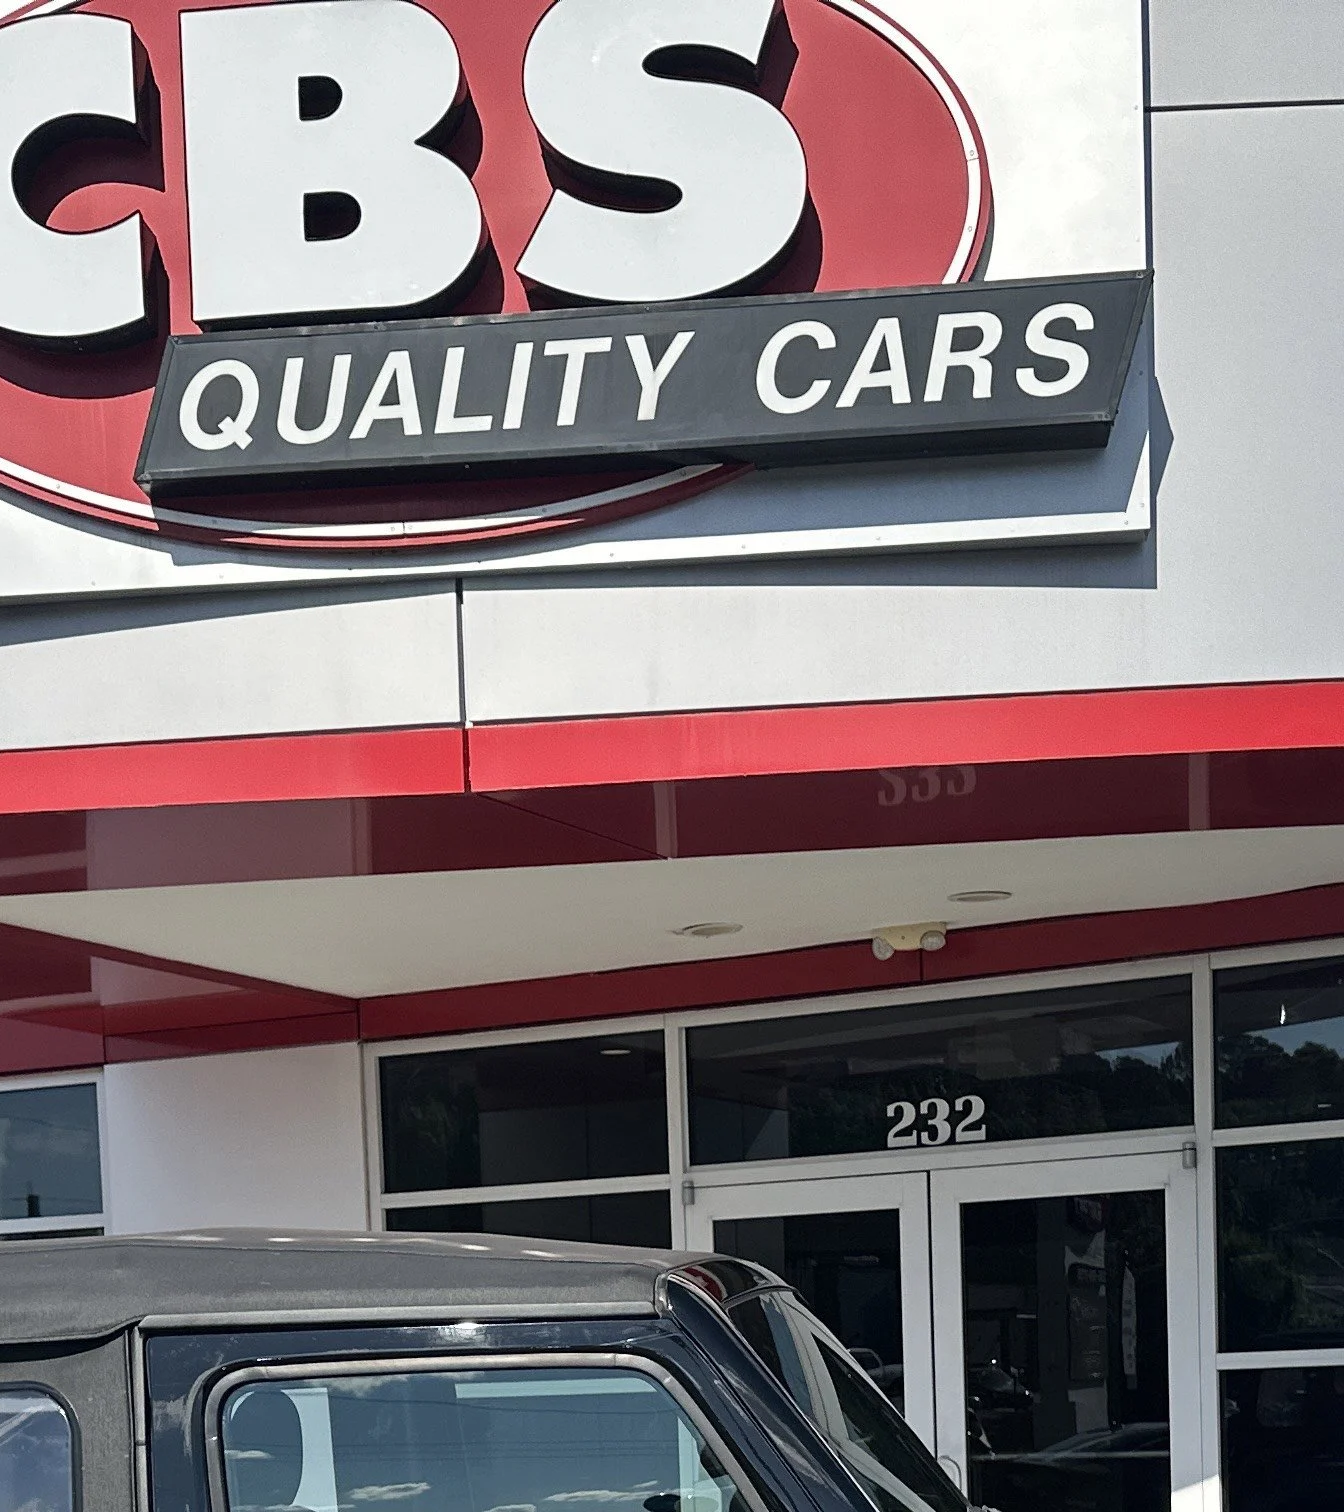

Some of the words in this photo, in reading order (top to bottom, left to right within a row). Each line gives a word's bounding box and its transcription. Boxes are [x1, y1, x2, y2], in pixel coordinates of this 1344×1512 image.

[177, 330, 699, 451] QUALITY
[755, 300, 1097, 416] CARS
[886, 1095, 988, 1148] 232
